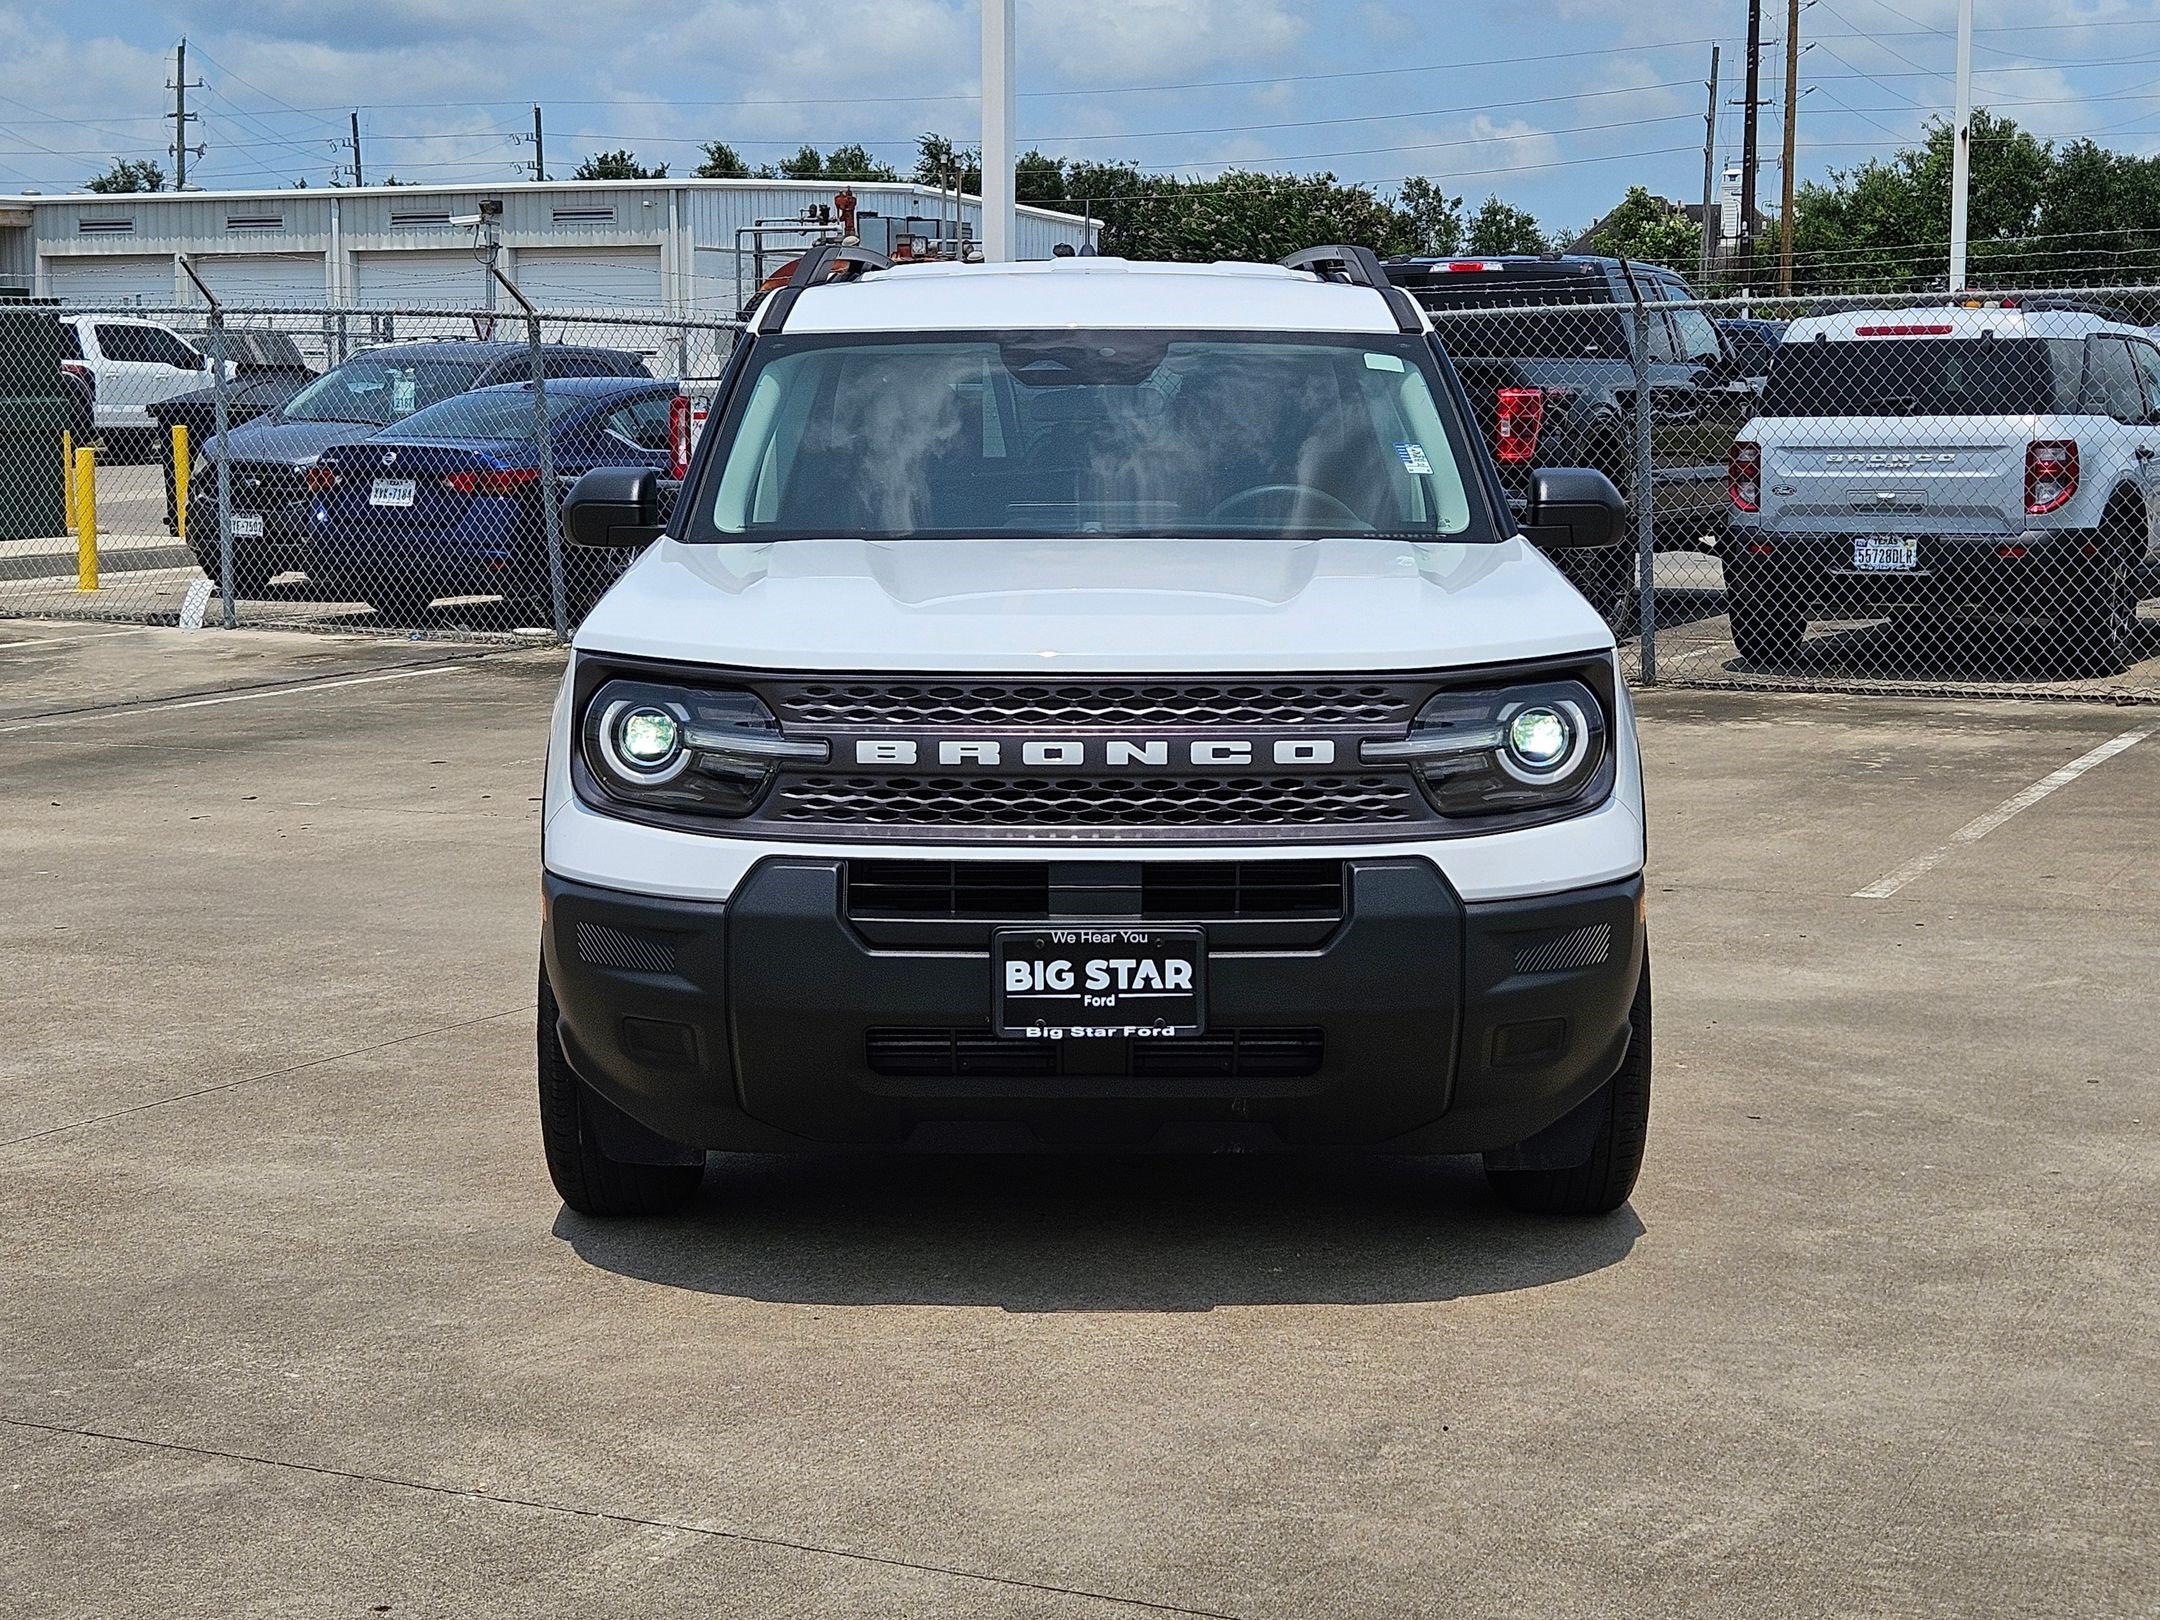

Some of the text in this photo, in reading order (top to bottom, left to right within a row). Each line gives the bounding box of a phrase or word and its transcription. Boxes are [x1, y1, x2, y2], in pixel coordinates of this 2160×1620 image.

[1826, 454, 1956, 463] BRONCO
[1857, 548, 1913, 564] 55728DLR
[855, 740, 1336, 766] BRONCO
[1052, 931, 1148, 944] We Hear You
[1005, 959, 1193, 992] BIG STAR
[1084, 994, 1116, 1007] Ford
[1026, 1026, 1175, 1039] Big Star Ford
